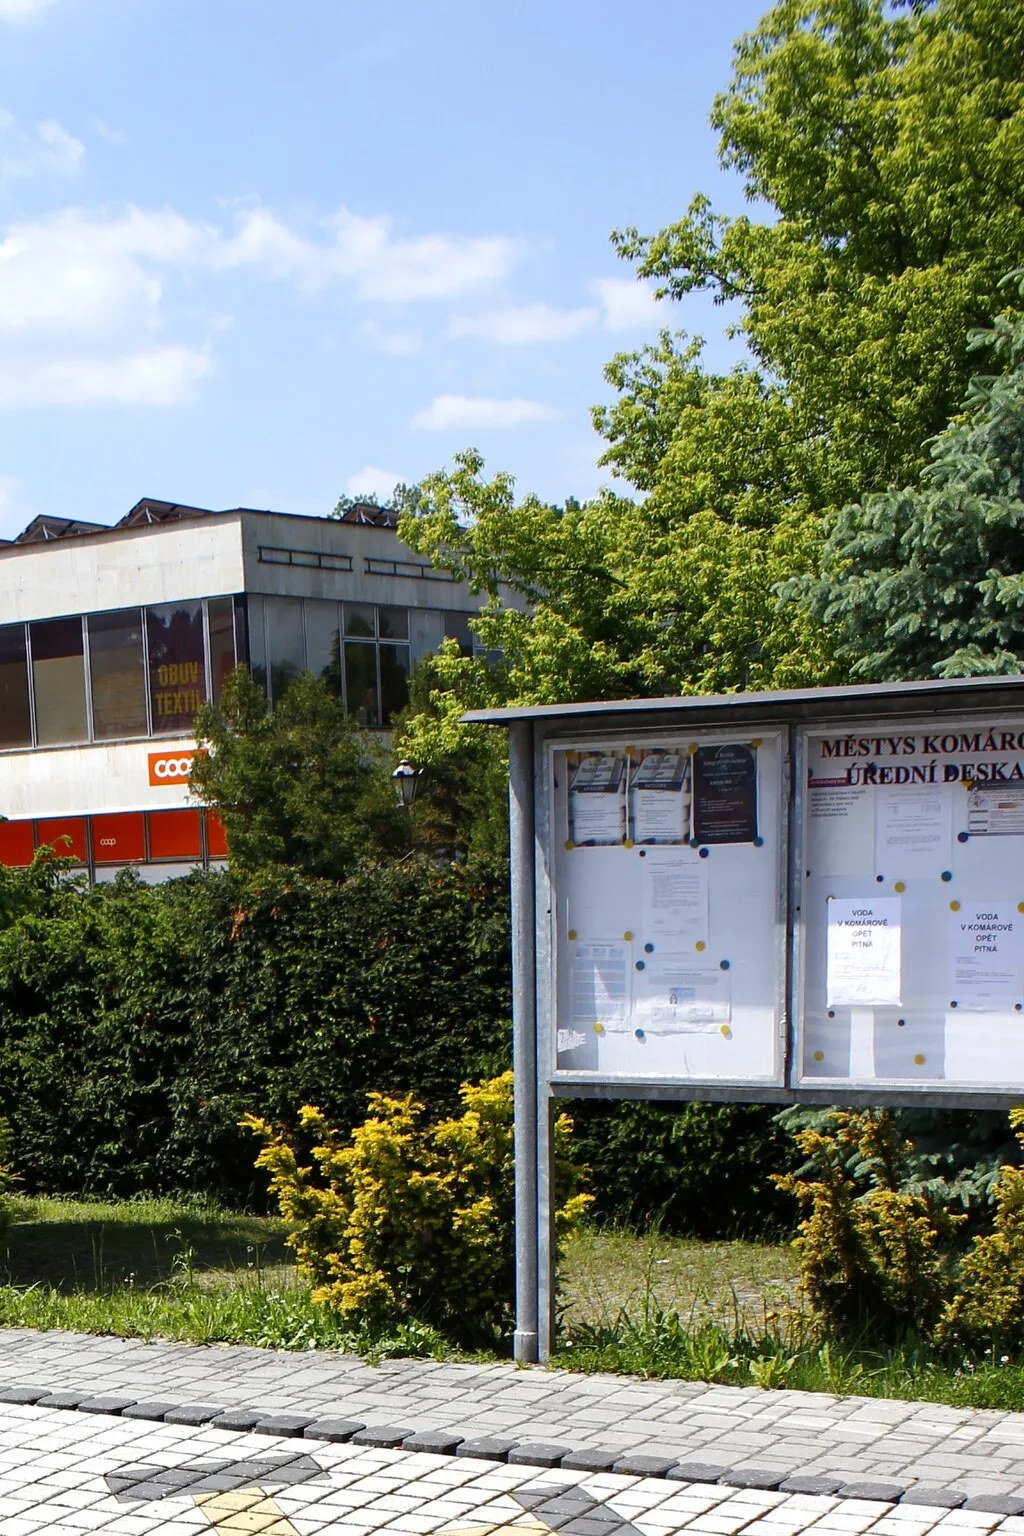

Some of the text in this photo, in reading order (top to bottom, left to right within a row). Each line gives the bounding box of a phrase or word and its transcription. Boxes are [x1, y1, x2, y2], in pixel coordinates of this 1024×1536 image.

[158, 661, 198, 687] OBUV
[820, 734, 916, 758] MĚSTYS
[154, 757, 195, 778] coo
[846, 760, 1024, 786] ÚŘEDNÍ DESKA
[851, 909, 873, 917] VODA
[976, 913, 999, 921] VODA
